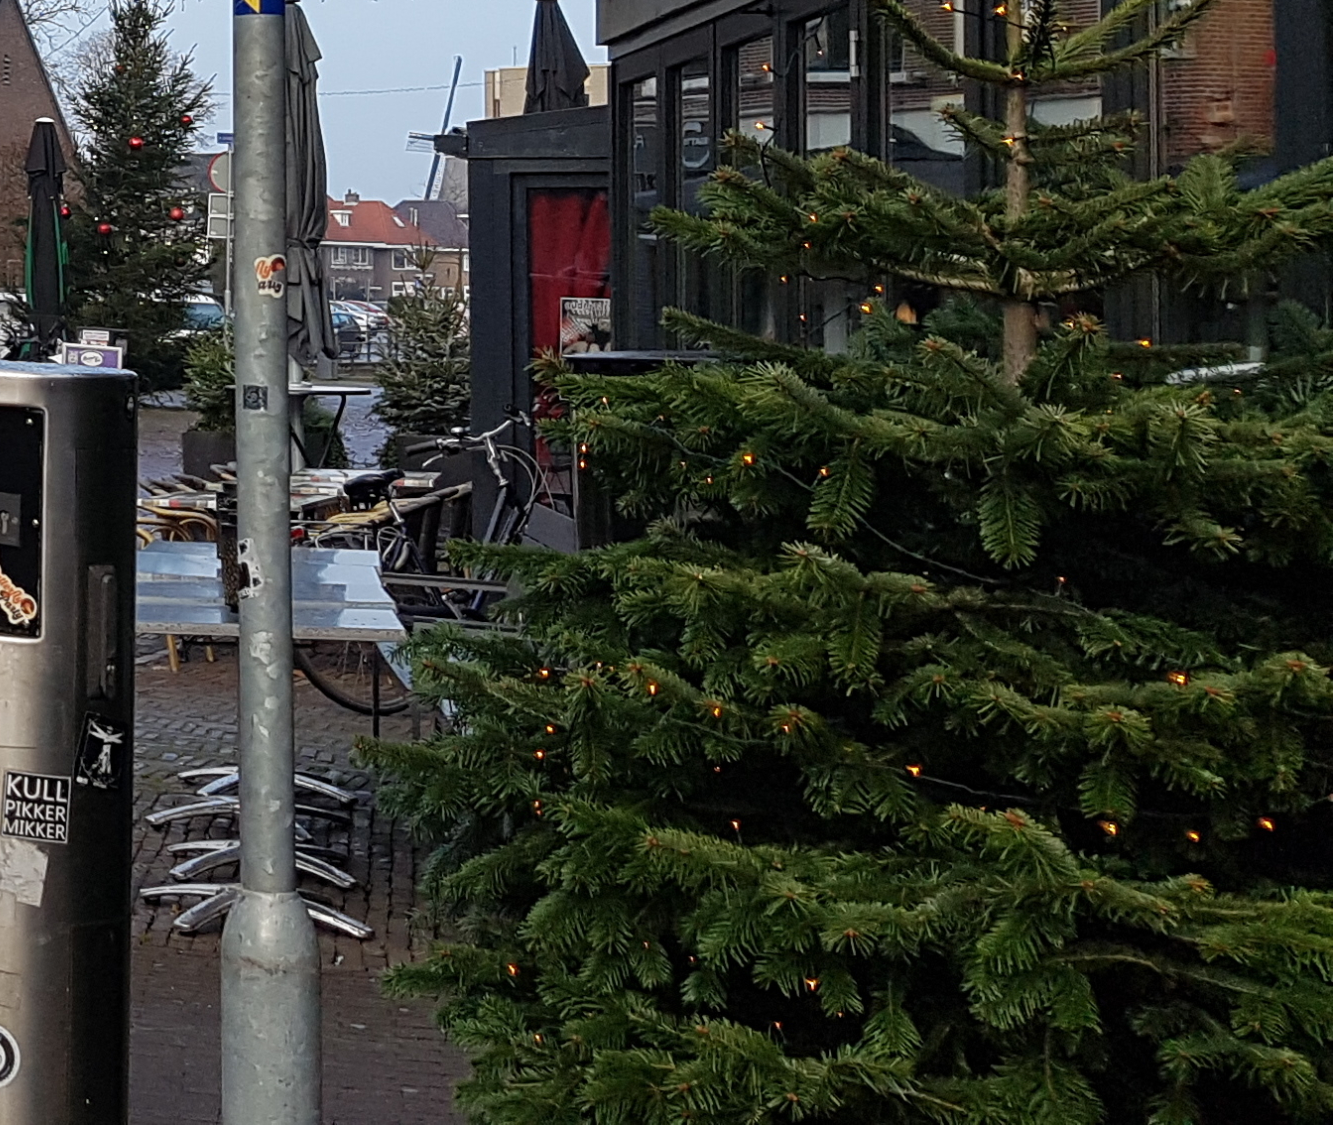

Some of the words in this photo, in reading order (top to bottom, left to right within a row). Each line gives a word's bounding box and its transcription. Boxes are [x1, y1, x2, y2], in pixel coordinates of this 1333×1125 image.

[6, 774, 68, 802] KULL
[5, 799, 66, 822] PIKKER
[3, 818, 65, 840] MIKKER
